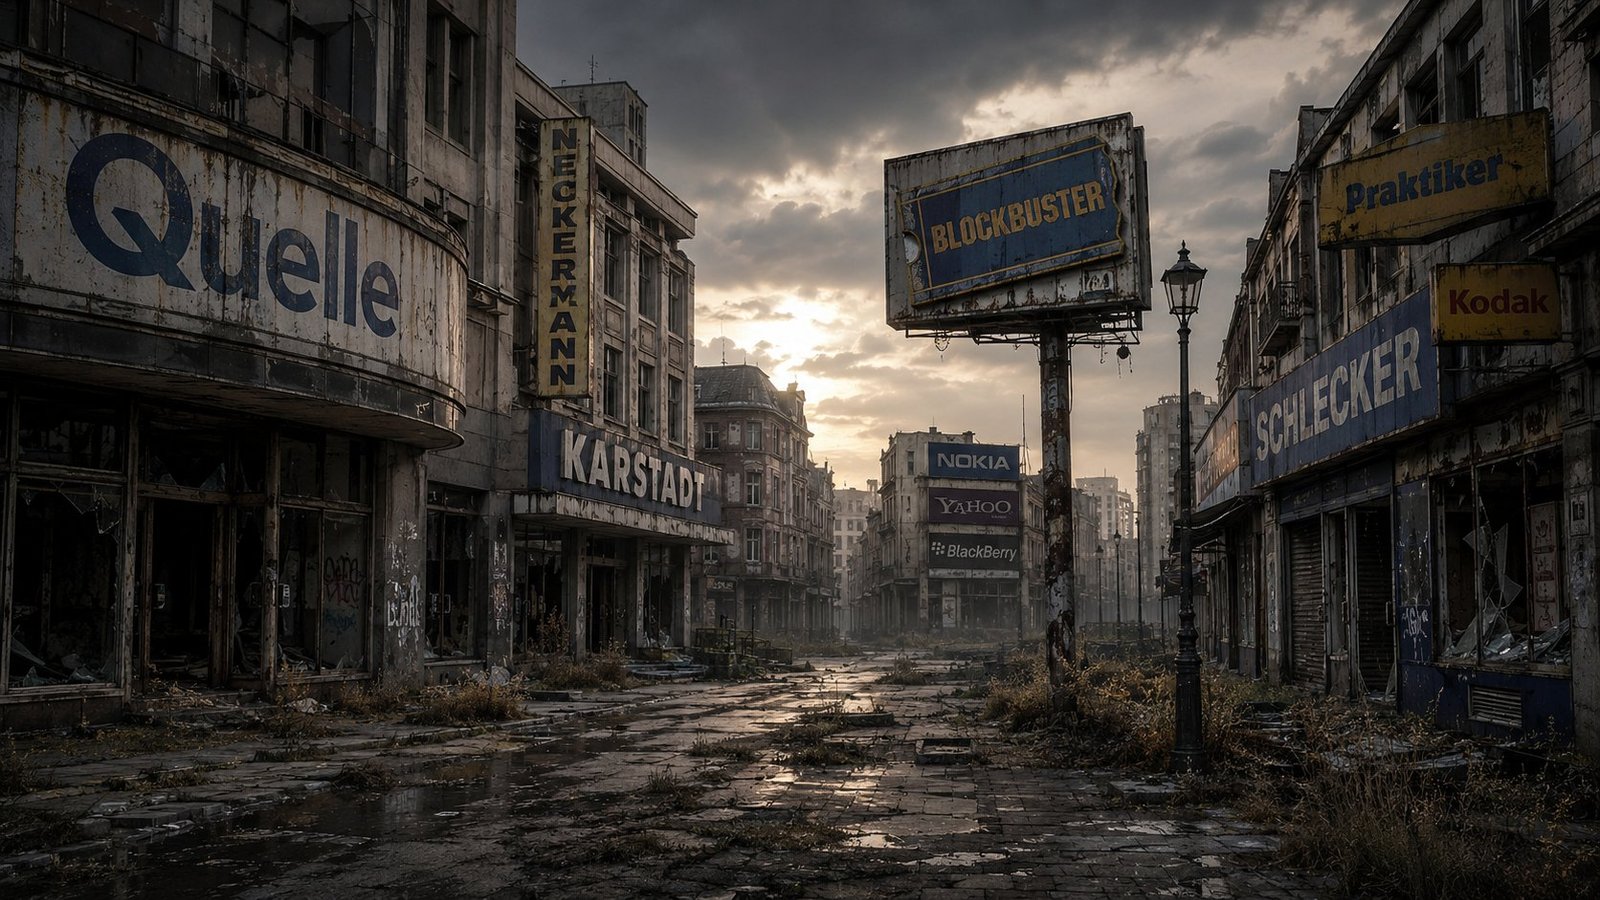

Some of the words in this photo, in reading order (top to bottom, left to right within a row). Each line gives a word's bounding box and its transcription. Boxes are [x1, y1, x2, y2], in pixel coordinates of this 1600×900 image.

[931, 181, 1105, 254] BLOCKBUSTER
[1346, 153, 1503, 215] Praktiker
[66, 133, 399, 338] Quelle
[550, 128, 577, 386] NECKERMANN
[1450, 288, 1550, 315] Kodak
[1256, 326, 1422, 462] SCHLECKER
[561, 429, 704, 512] KARSTADT
[937, 453, 1010, 470] NOKIA
[934, 497, 1012, 515] YAHOO
[947, 544, 1017, 562] BlackBerry
